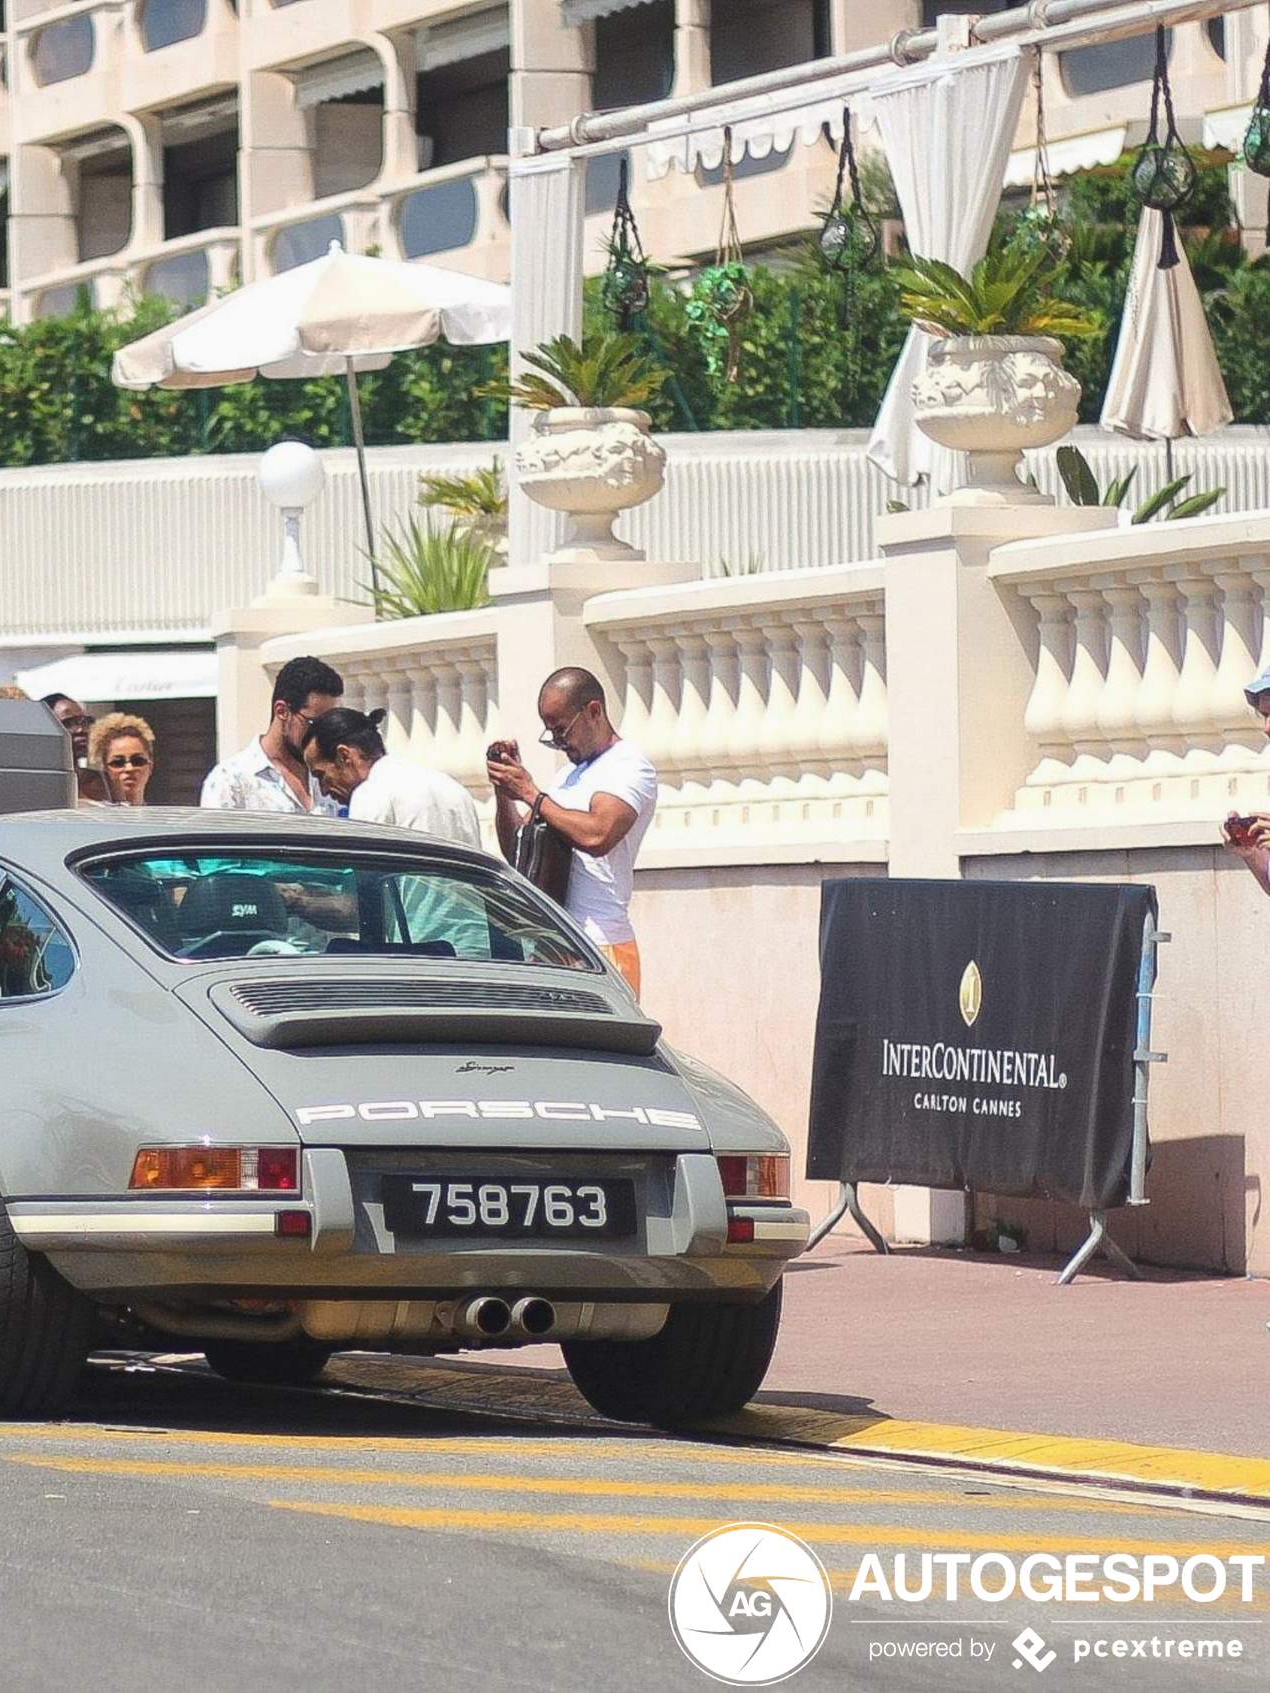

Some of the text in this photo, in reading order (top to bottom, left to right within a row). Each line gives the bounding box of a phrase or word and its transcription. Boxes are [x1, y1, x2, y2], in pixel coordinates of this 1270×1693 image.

[295, 1099, 703, 1131] PORSCHE
[914, 1093, 1022, 1118] CARLTON CANNES
[411, 1182, 608, 1228] 758763
